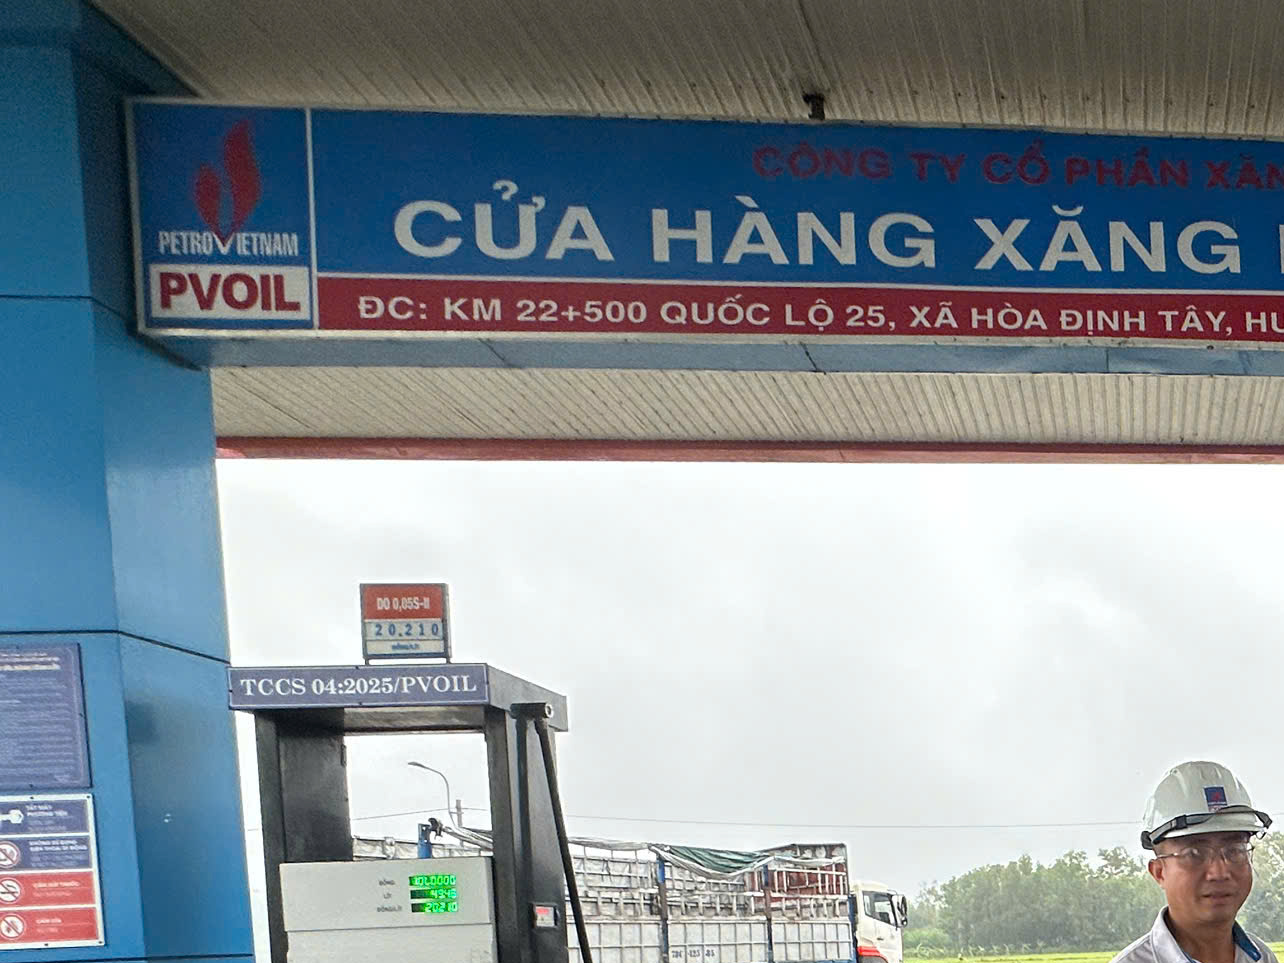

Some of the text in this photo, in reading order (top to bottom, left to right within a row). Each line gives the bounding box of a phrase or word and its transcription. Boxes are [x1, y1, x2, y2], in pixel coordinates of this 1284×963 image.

[753, 141, 892, 179] CÔNG
[909, 151, 966, 182] TY
[982, 139, 1050, 185] CỔ
[394, 180, 615, 261] CỬA
[652, 195, 935, 268] HÀNG
[974, 204, 1241, 274] XĂNG
[160, 272, 301, 311] PVOIL
[358, 295, 428, 320] ĐC:
[444, 297, 501, 321] KM
[517, 299, 647, 323] 22+500
[660, 293, 770, 325] QUỐC
[785, 298, 834, 331] LỘ
[846, 305, 896, 330] 25,
[909, 301, 958, 329] XÃ
[971, 302, 1048, 330] HÒA
[1060, 309, 1145, 335] ĐỊNH
[1158, 304, 1232, 336] TÂY,
[240, 675, 477, 696] TCCS 04:2025/PVOIL
